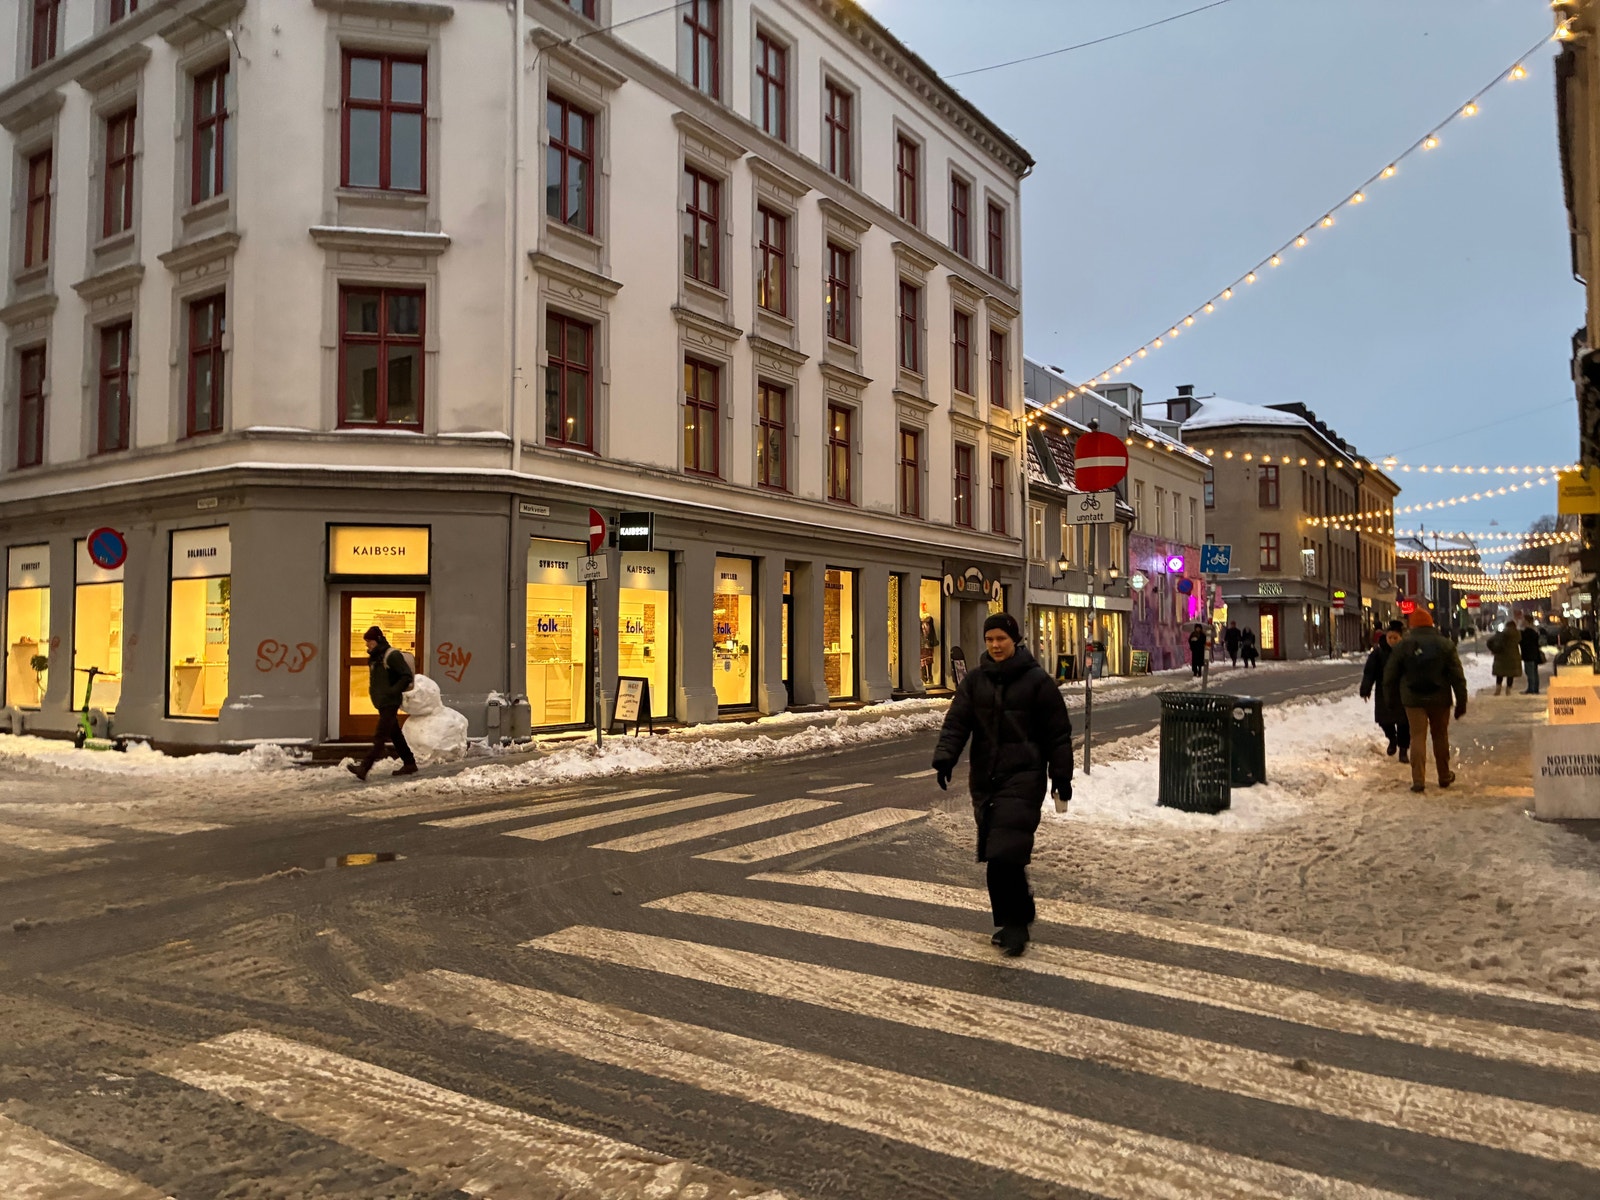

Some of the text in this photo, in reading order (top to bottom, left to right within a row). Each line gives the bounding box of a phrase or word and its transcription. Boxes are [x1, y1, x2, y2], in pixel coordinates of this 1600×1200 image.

[523, 504, 548, 514] Markveien
[1076, 513, 1104, 522] unntatt
[353, 546, 406, 556] KAIBOSH
[539, 560, 569, 569] SYNSTEST
[537, 618, 558, 632] folk
[626, 620, 644, 634] folk
[717, 622, 731, 634] folk
[1541, 766, 1600, 777] PLAYGROUN
